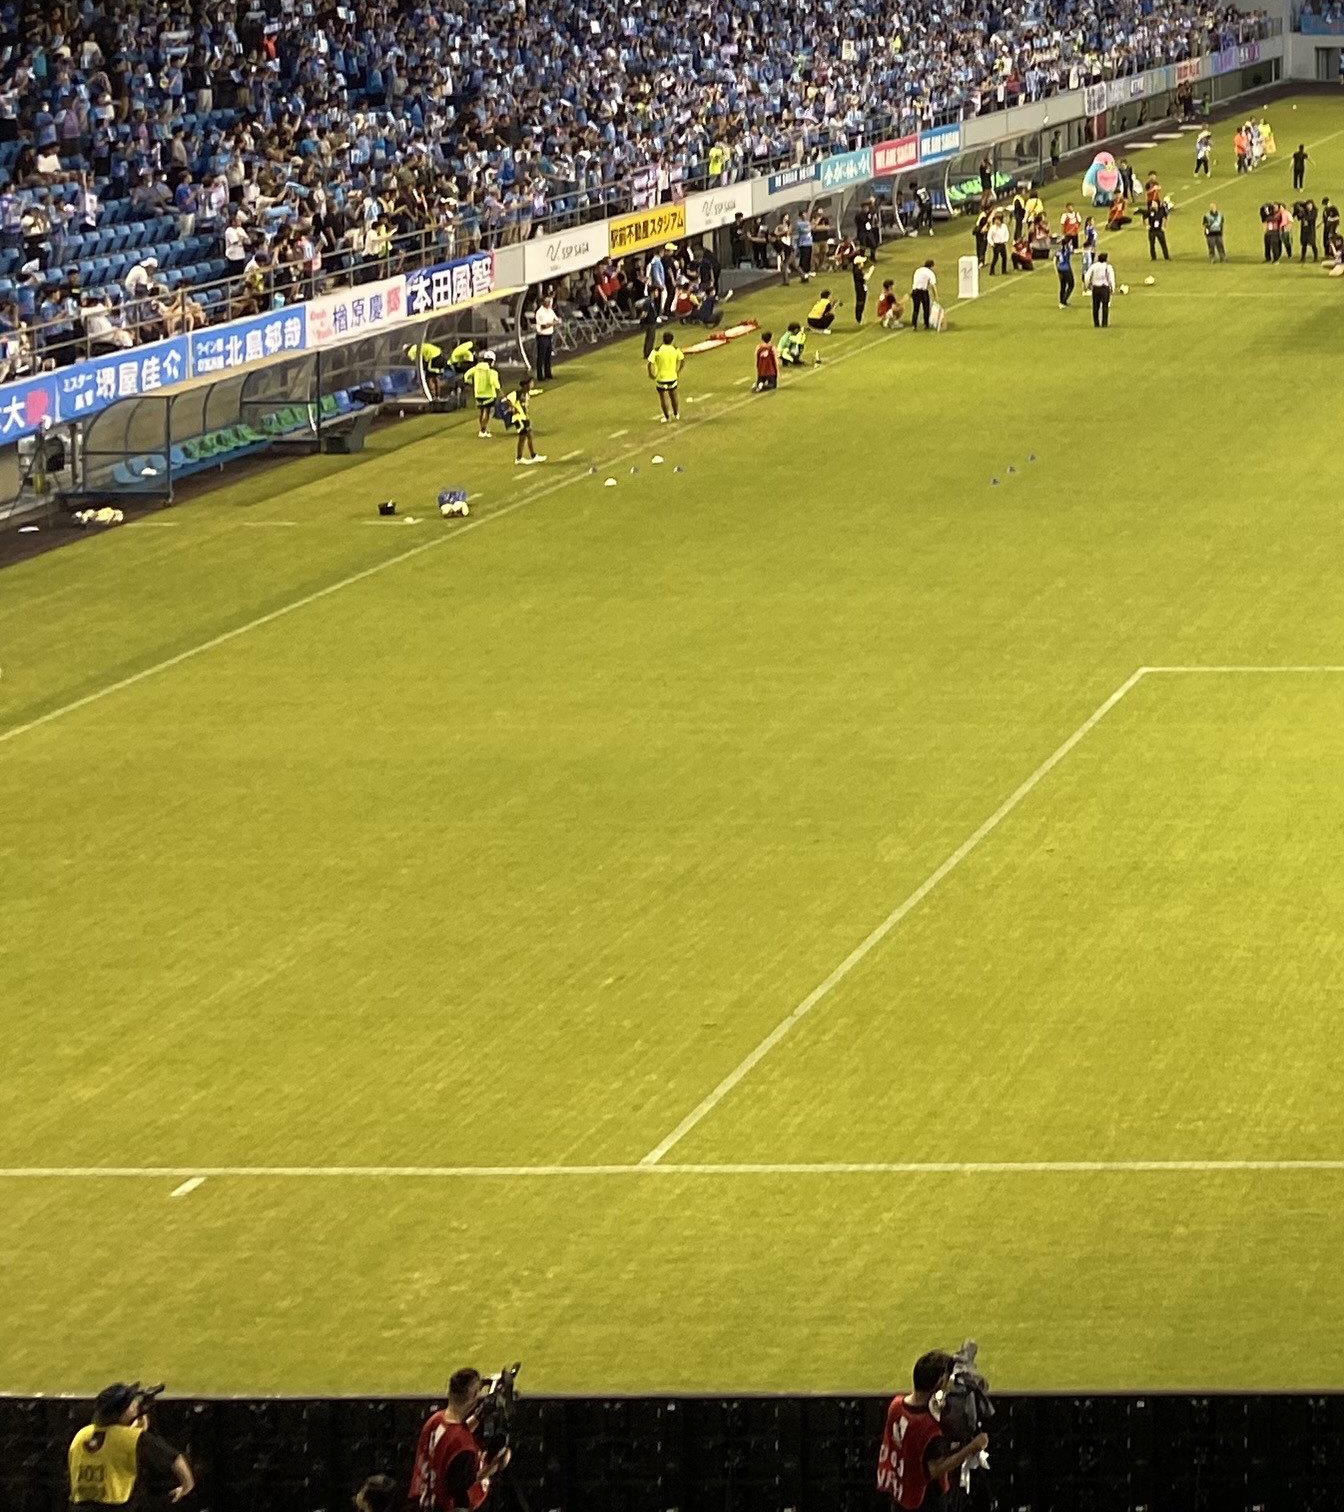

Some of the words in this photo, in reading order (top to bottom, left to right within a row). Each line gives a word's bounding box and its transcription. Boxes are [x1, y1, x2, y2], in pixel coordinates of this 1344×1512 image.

[611, 212, 684, 248] 駅前不動産スタジアム
